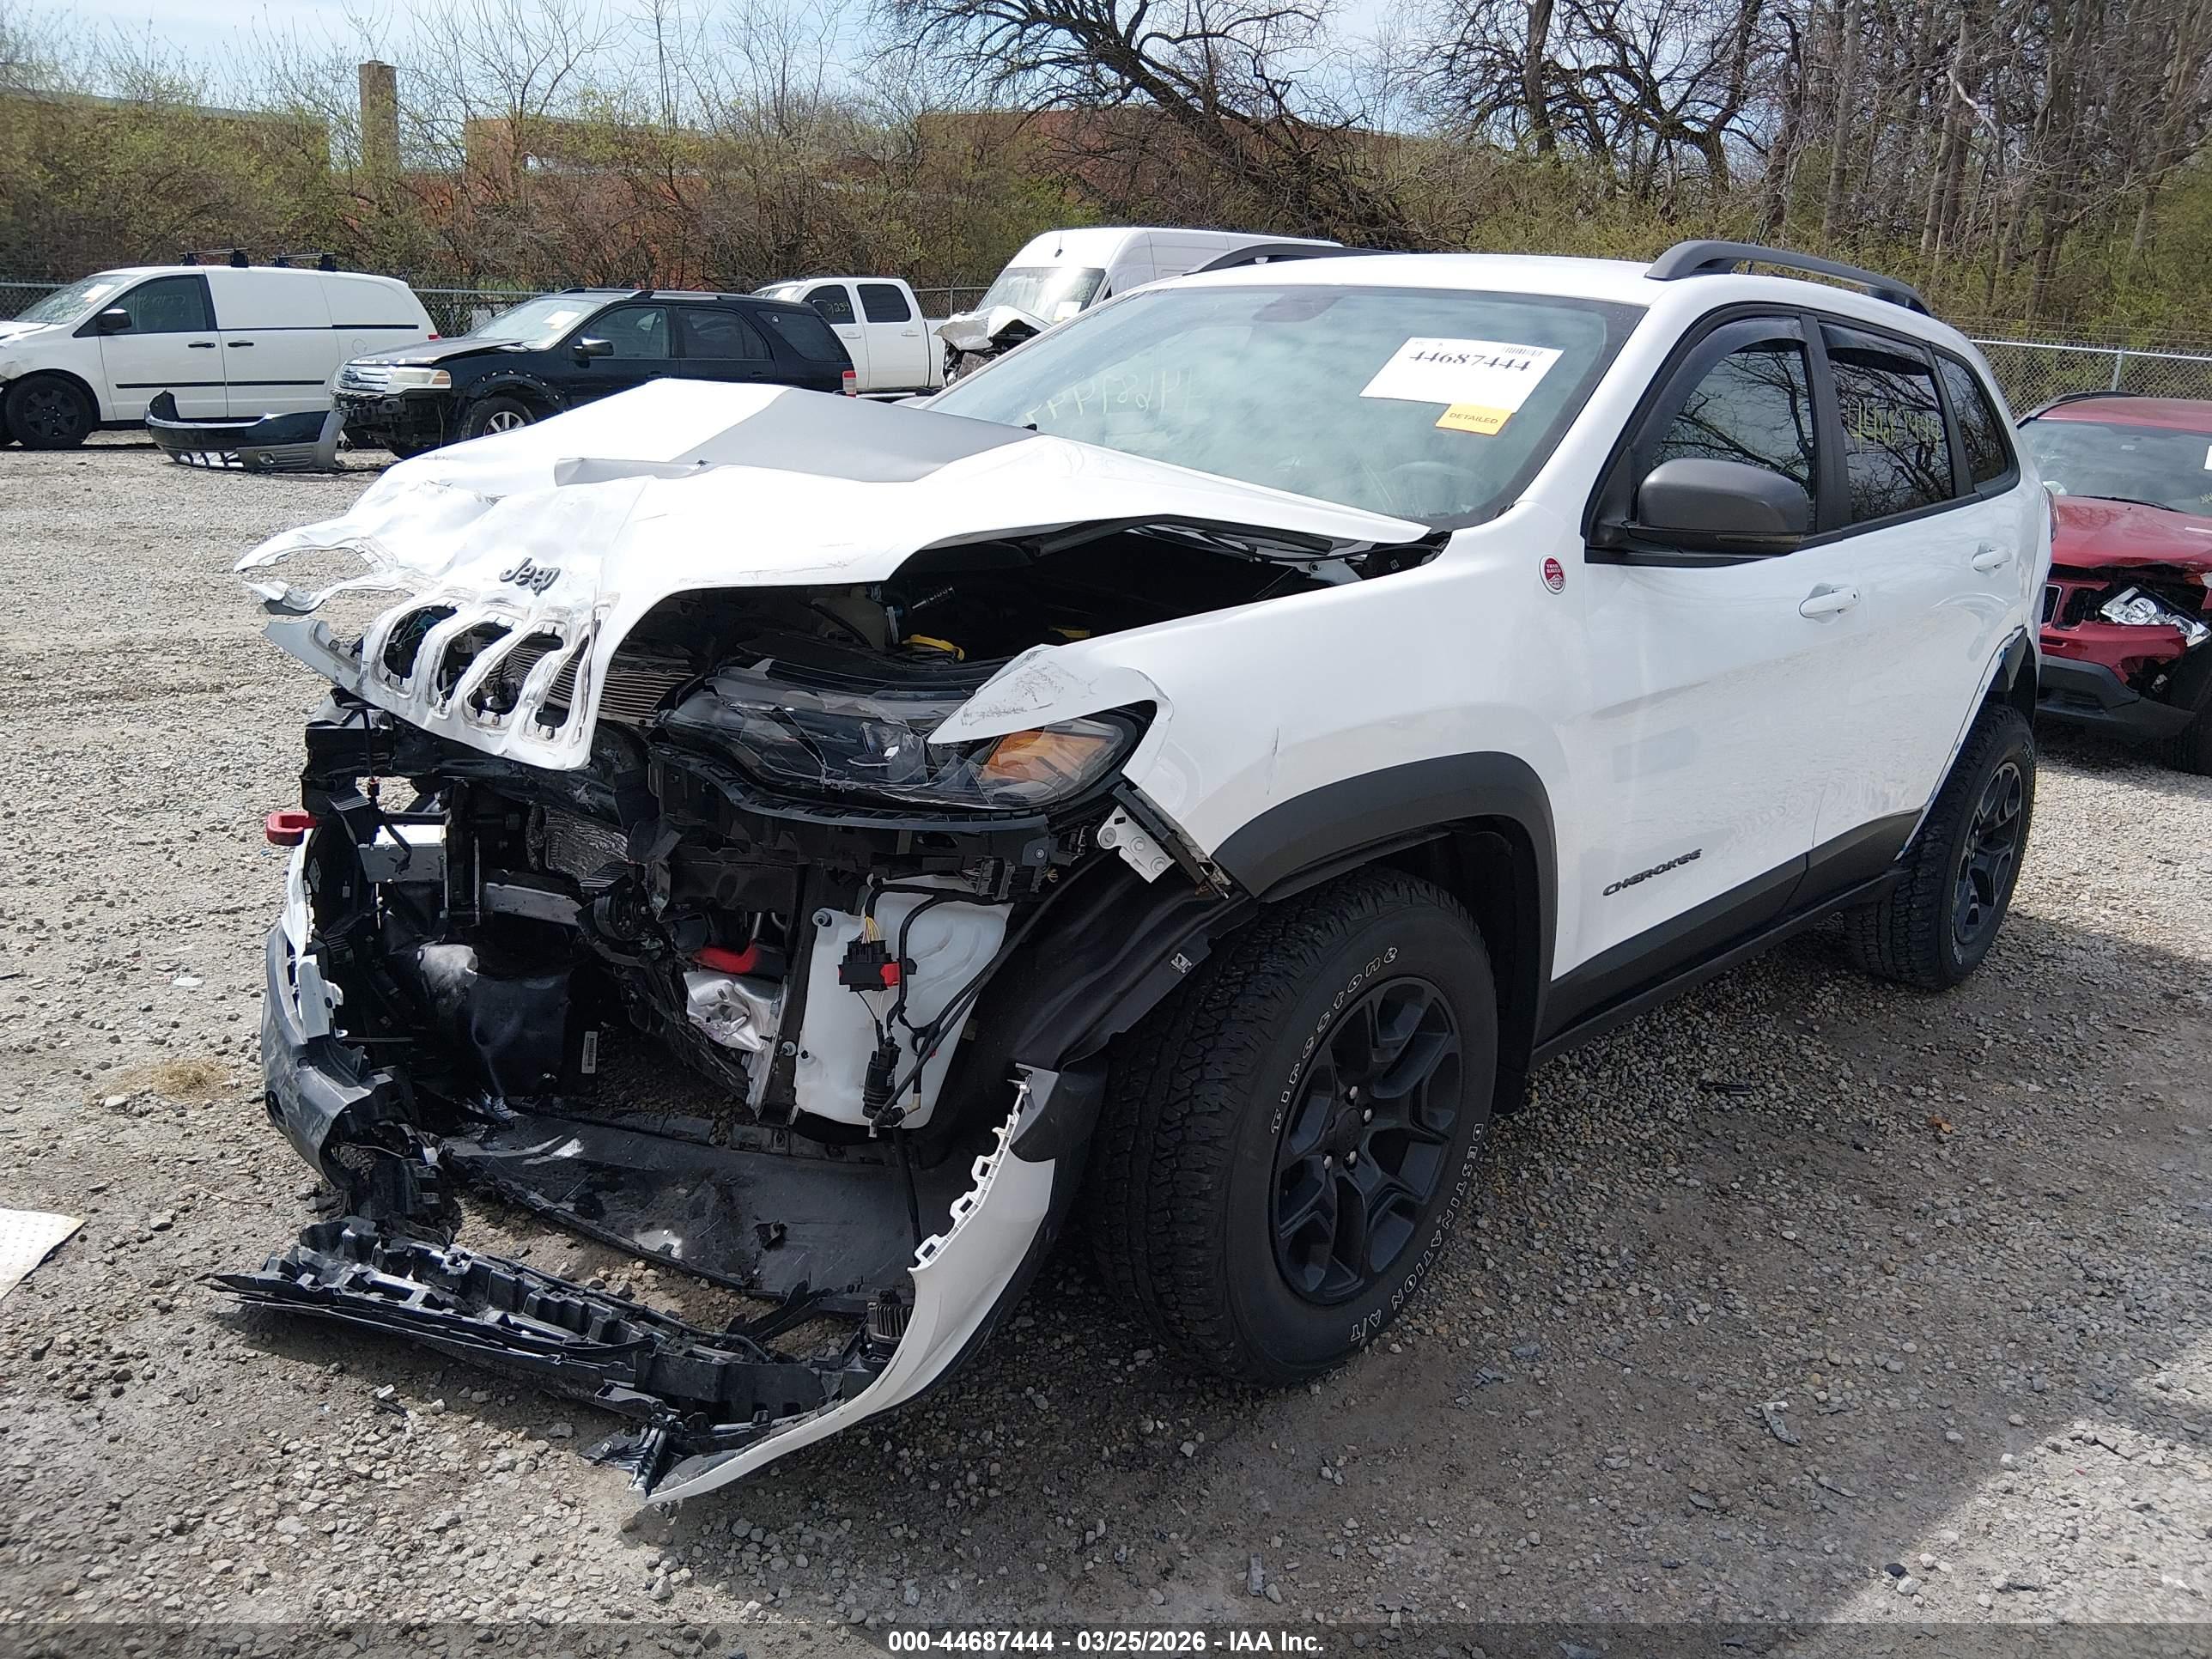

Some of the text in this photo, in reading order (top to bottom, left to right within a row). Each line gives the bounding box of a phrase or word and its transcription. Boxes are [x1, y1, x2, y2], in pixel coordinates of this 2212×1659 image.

[1408, 350, 1532, 372] 44687444
[1448, 411, 1499, 424] DETAILED
[498, 556, 561, 598] Jeep
[1602, 848, 1703, 896] CHEROKEE
[1350, 1122, 1484, 1350] DESTINATION A/T
